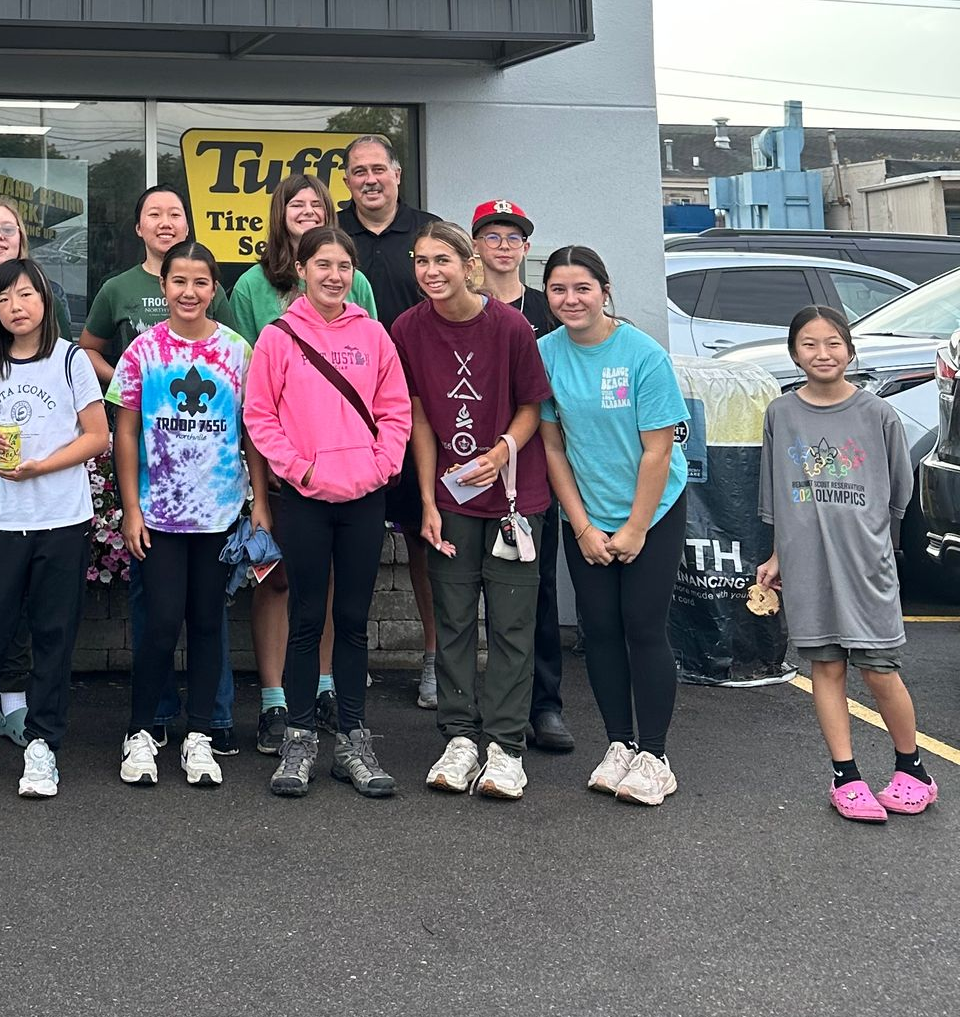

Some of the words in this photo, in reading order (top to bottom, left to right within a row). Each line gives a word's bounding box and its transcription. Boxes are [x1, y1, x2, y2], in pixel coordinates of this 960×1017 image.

[196, 141, 348, 199] Tuff
[40, 187, 84, 214] BEHIND
[207, 210, 263, 232] Tire
[141, 297, 169, 307] TROO
[601, 377, 630, 390] BEACH
[17, 384, 57, 410] ICONIC
[156, 417, 196, 433] TROOP
[792, 488, 812, 503] 202
[815, 489, 866, 506] OLYMPICS
